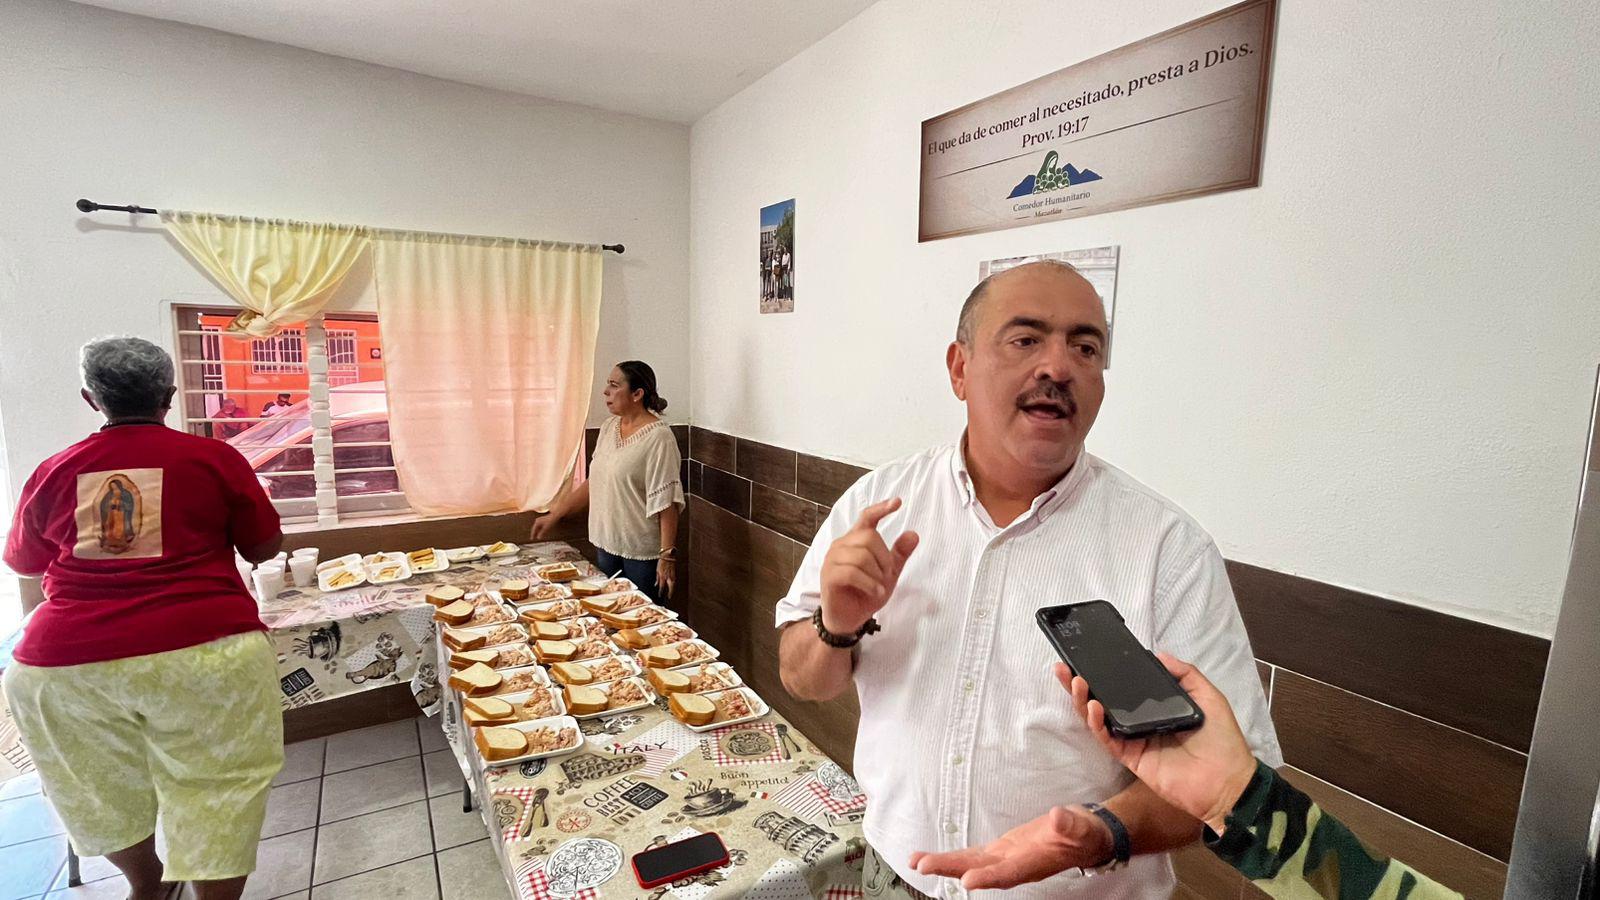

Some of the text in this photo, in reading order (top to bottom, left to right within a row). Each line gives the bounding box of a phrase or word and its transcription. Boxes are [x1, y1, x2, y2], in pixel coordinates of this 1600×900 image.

[928, 42, 1254, 155] El que da de comer al necesitado, presta a Dios.
[1022, 115, 1090, 149] Prov. 19:17
[1012, 190, 1091, 213] Comedor Humanitario
[583, 775, 639, 808] COFFEE
[596, 797, 626, 818] BEST
